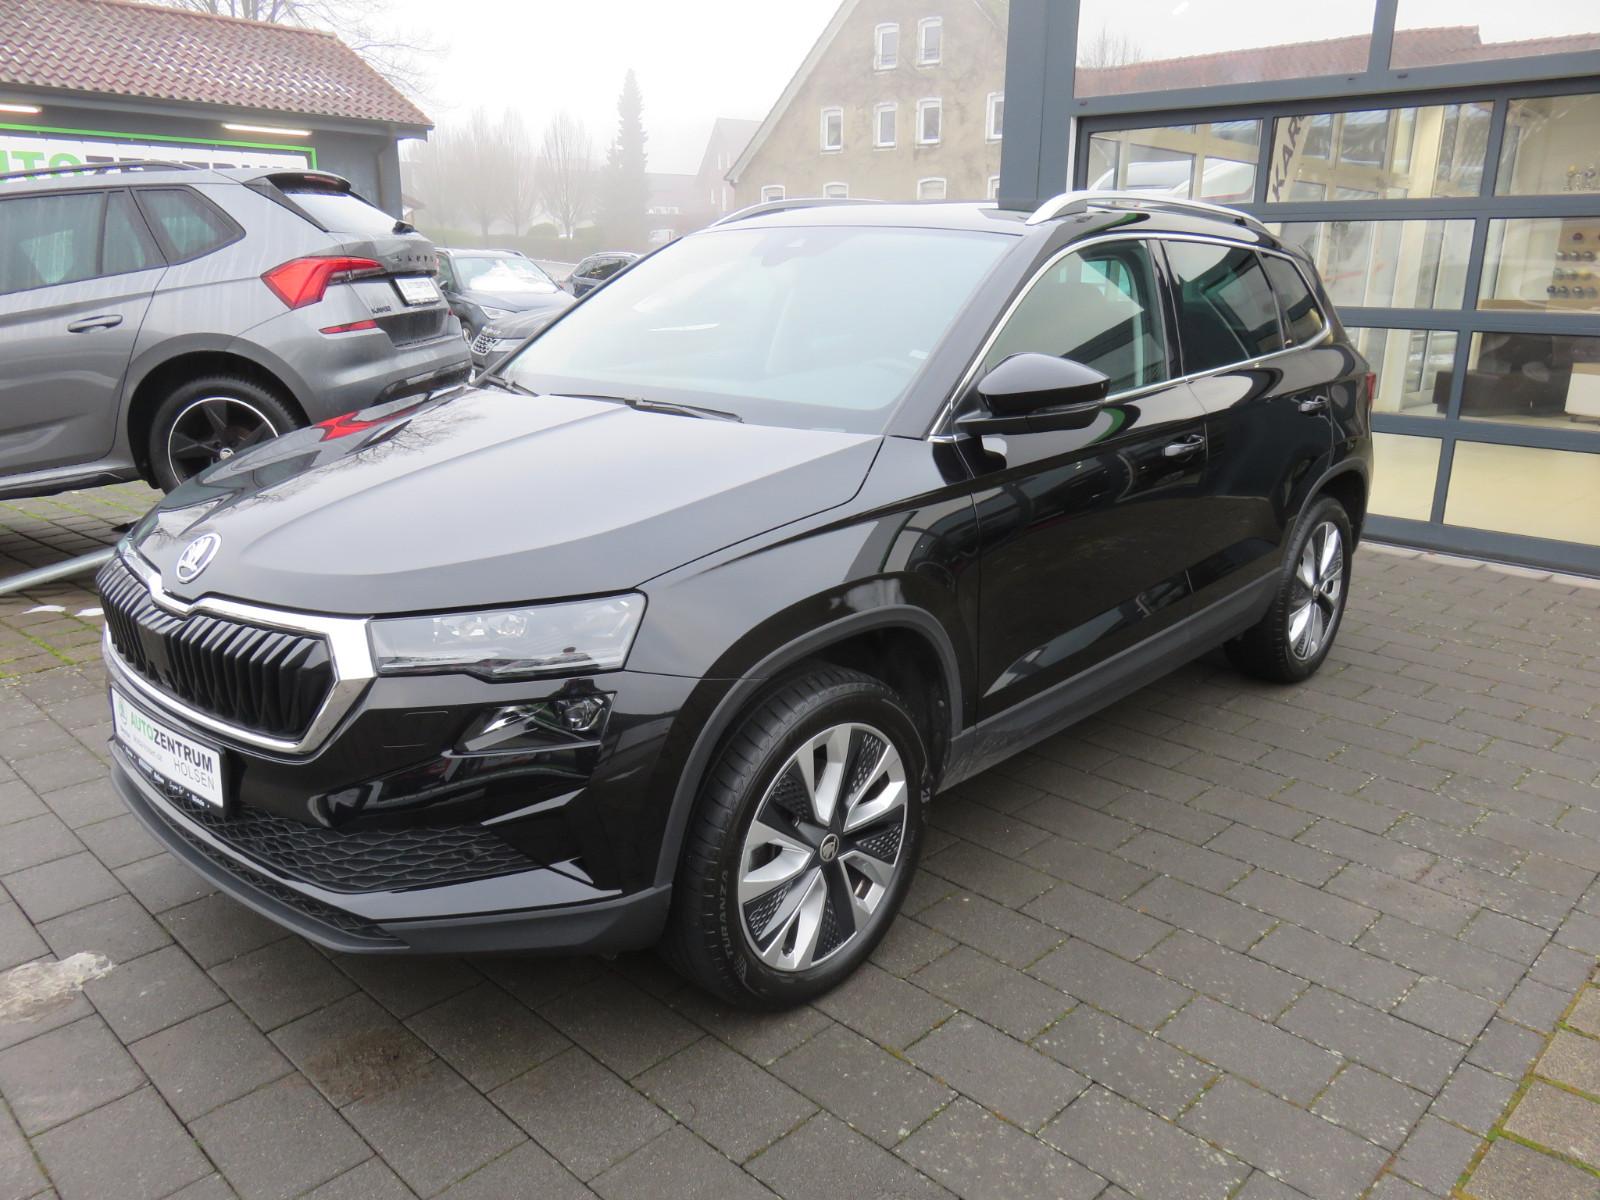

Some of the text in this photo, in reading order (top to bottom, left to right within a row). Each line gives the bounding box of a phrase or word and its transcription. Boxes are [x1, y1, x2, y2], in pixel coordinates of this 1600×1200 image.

[1272, 114, 1305, 202] KAR
[131, 711, 213, 774] AUTOZENTRUM
[173, 758, 215, 791] HOLSEN
[720, 869, 734, 960] TURANZA
